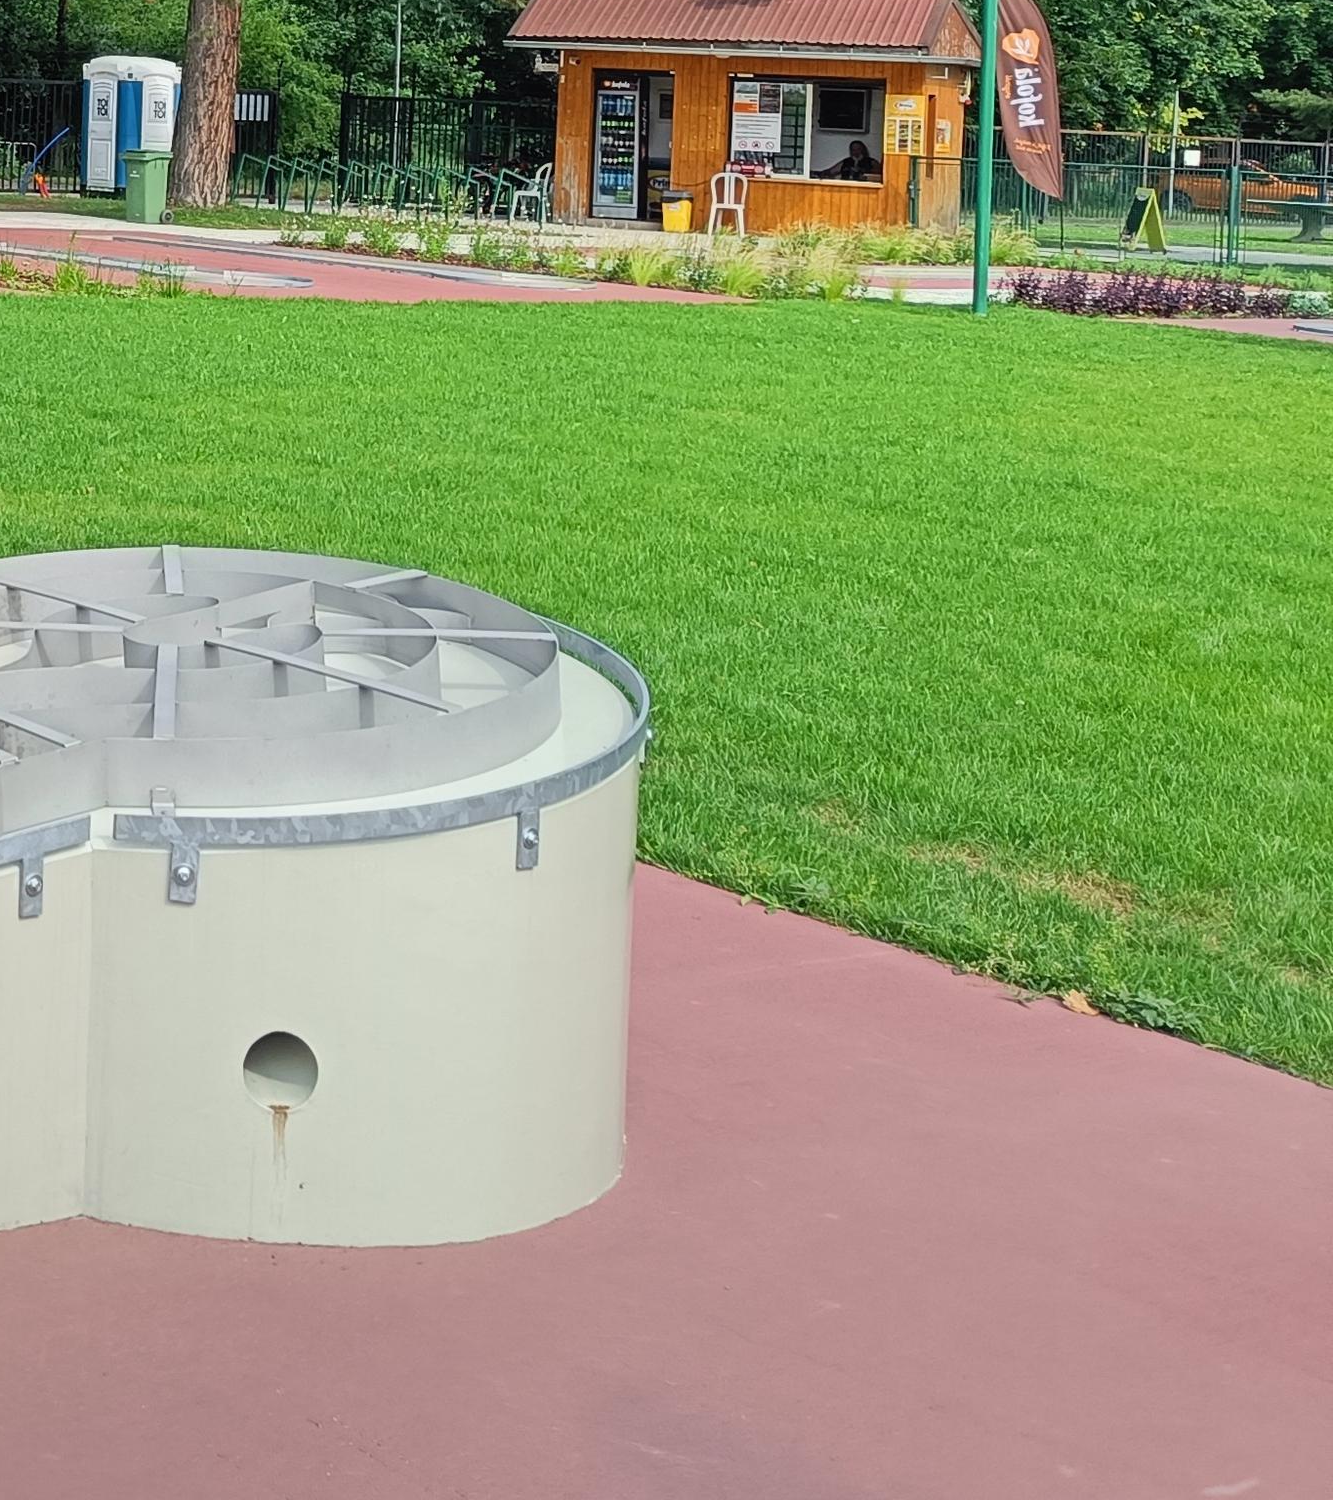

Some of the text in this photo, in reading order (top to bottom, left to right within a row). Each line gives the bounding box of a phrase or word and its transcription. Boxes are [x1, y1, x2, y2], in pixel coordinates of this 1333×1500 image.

[97, 98, 108, 108] TOI
[153, 100, 166, 110] TOI
[97, 107, 108, 116] TOI
[153, 109, 166, 118] TOI
